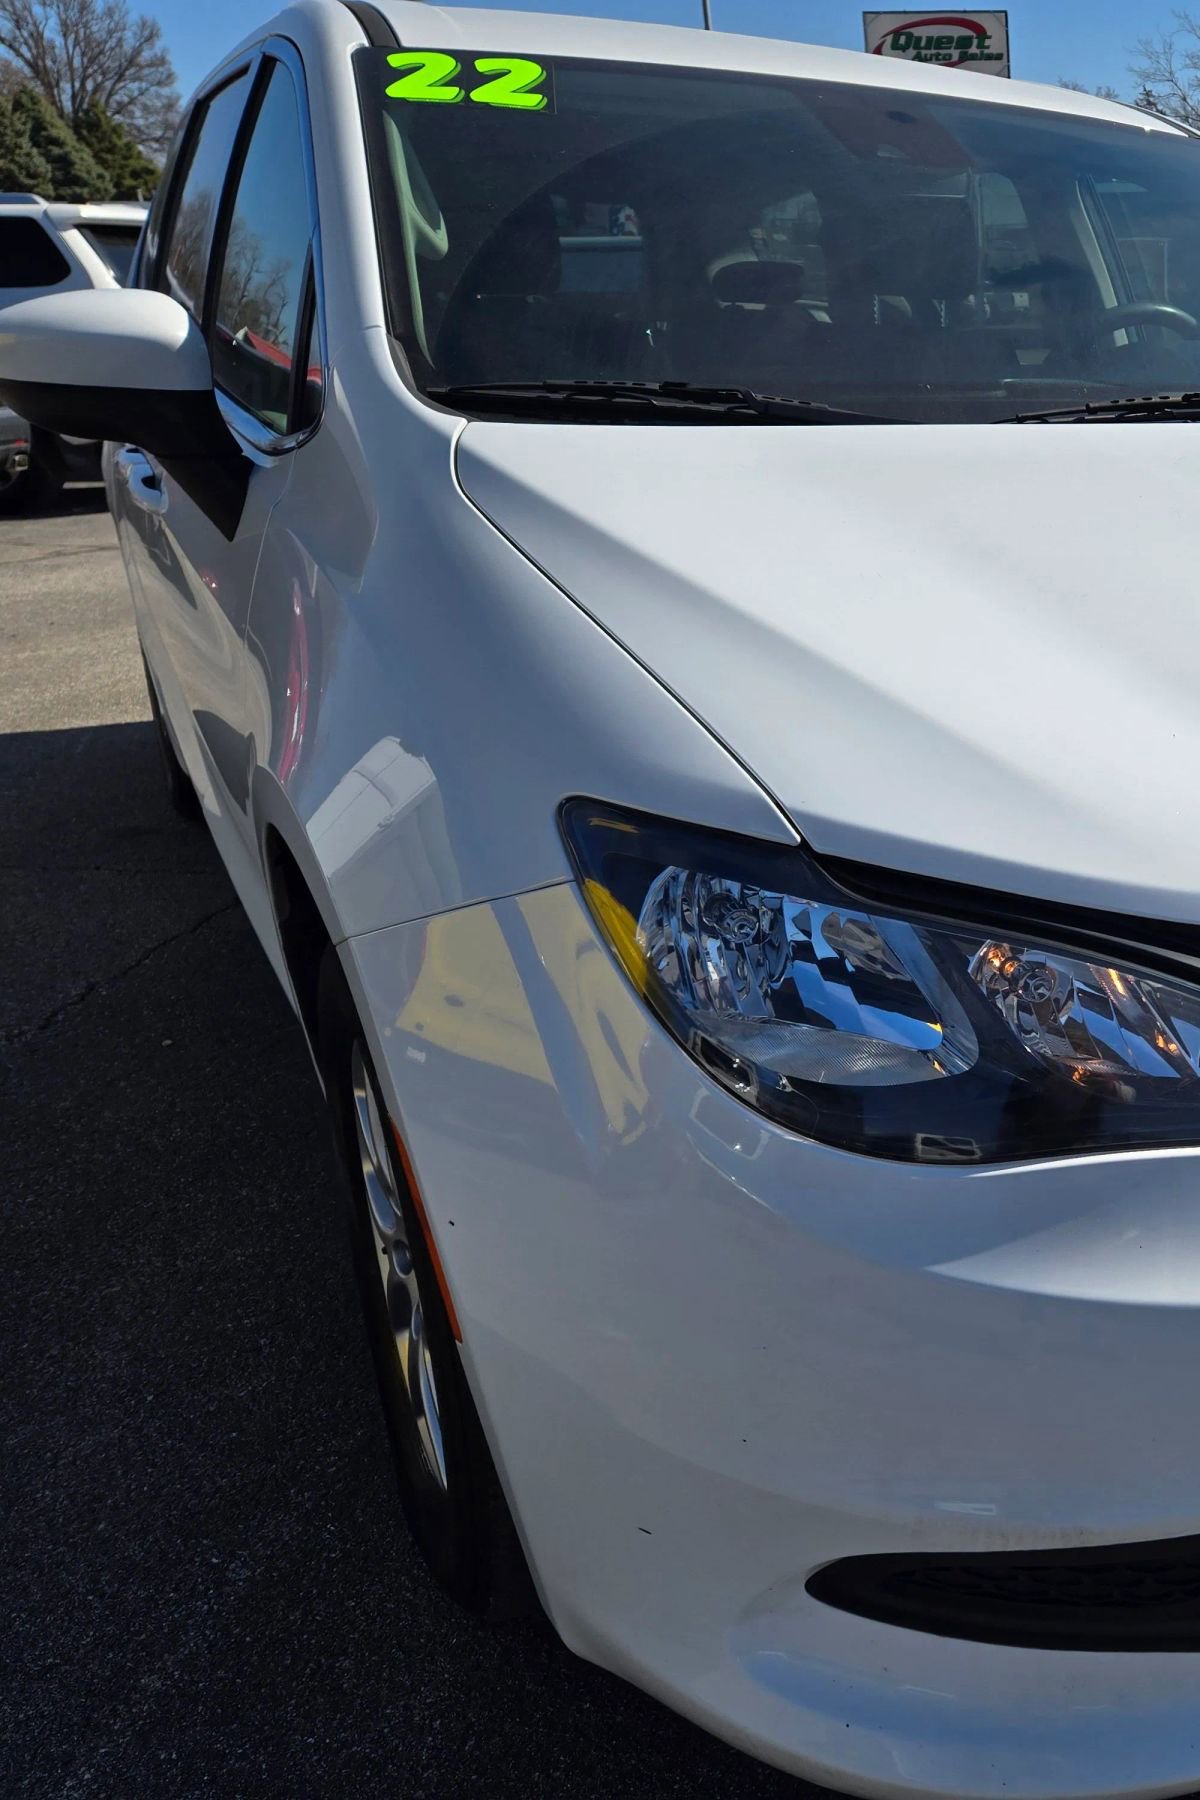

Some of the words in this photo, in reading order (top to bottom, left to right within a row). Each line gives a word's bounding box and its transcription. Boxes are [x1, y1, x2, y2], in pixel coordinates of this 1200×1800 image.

[891, 31, 992, 53] Quest
[911, 51, 952, 62] Auto
[959, 50, 1003, 61] Sales
[384, 51, 548, 111] 22
